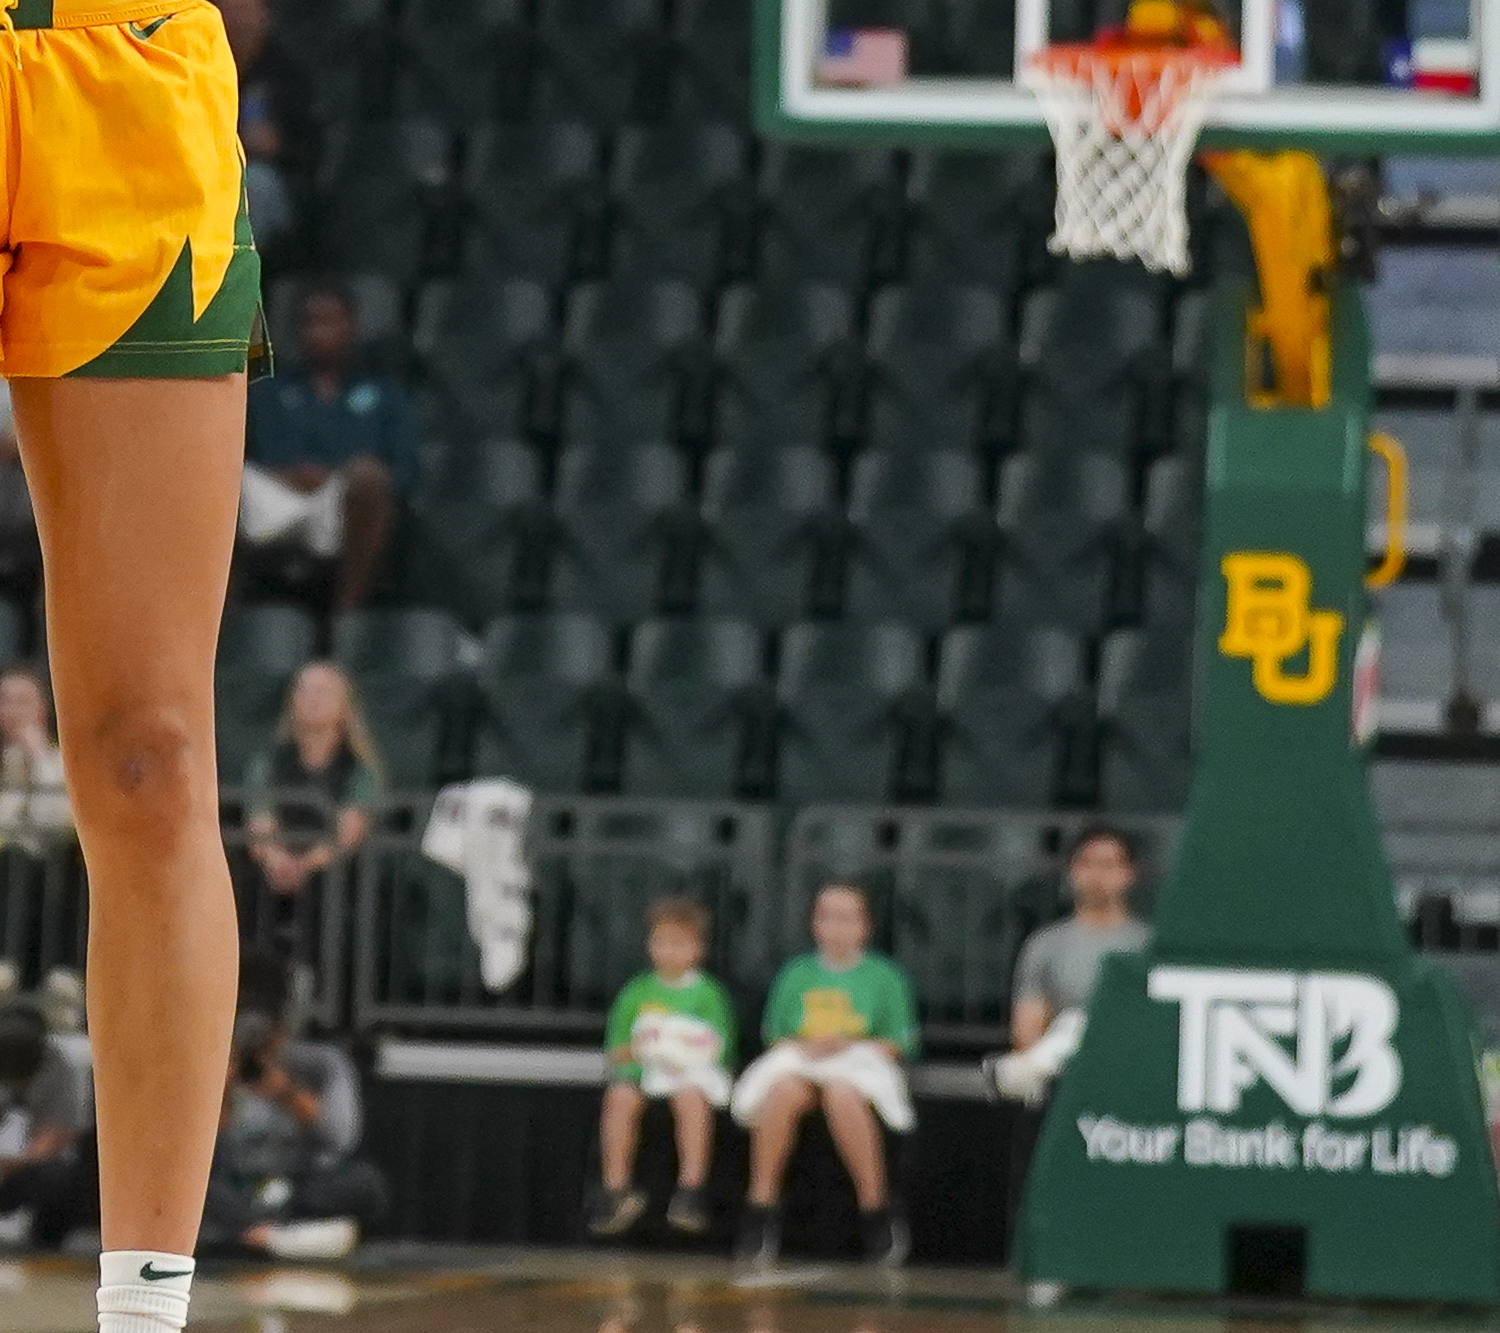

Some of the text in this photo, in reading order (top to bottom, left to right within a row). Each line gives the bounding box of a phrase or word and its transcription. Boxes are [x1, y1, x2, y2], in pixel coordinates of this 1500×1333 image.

[1219, 551, 1344, 705] BU
[1077, 1114, 1459, 1176] Your Bank for Life
